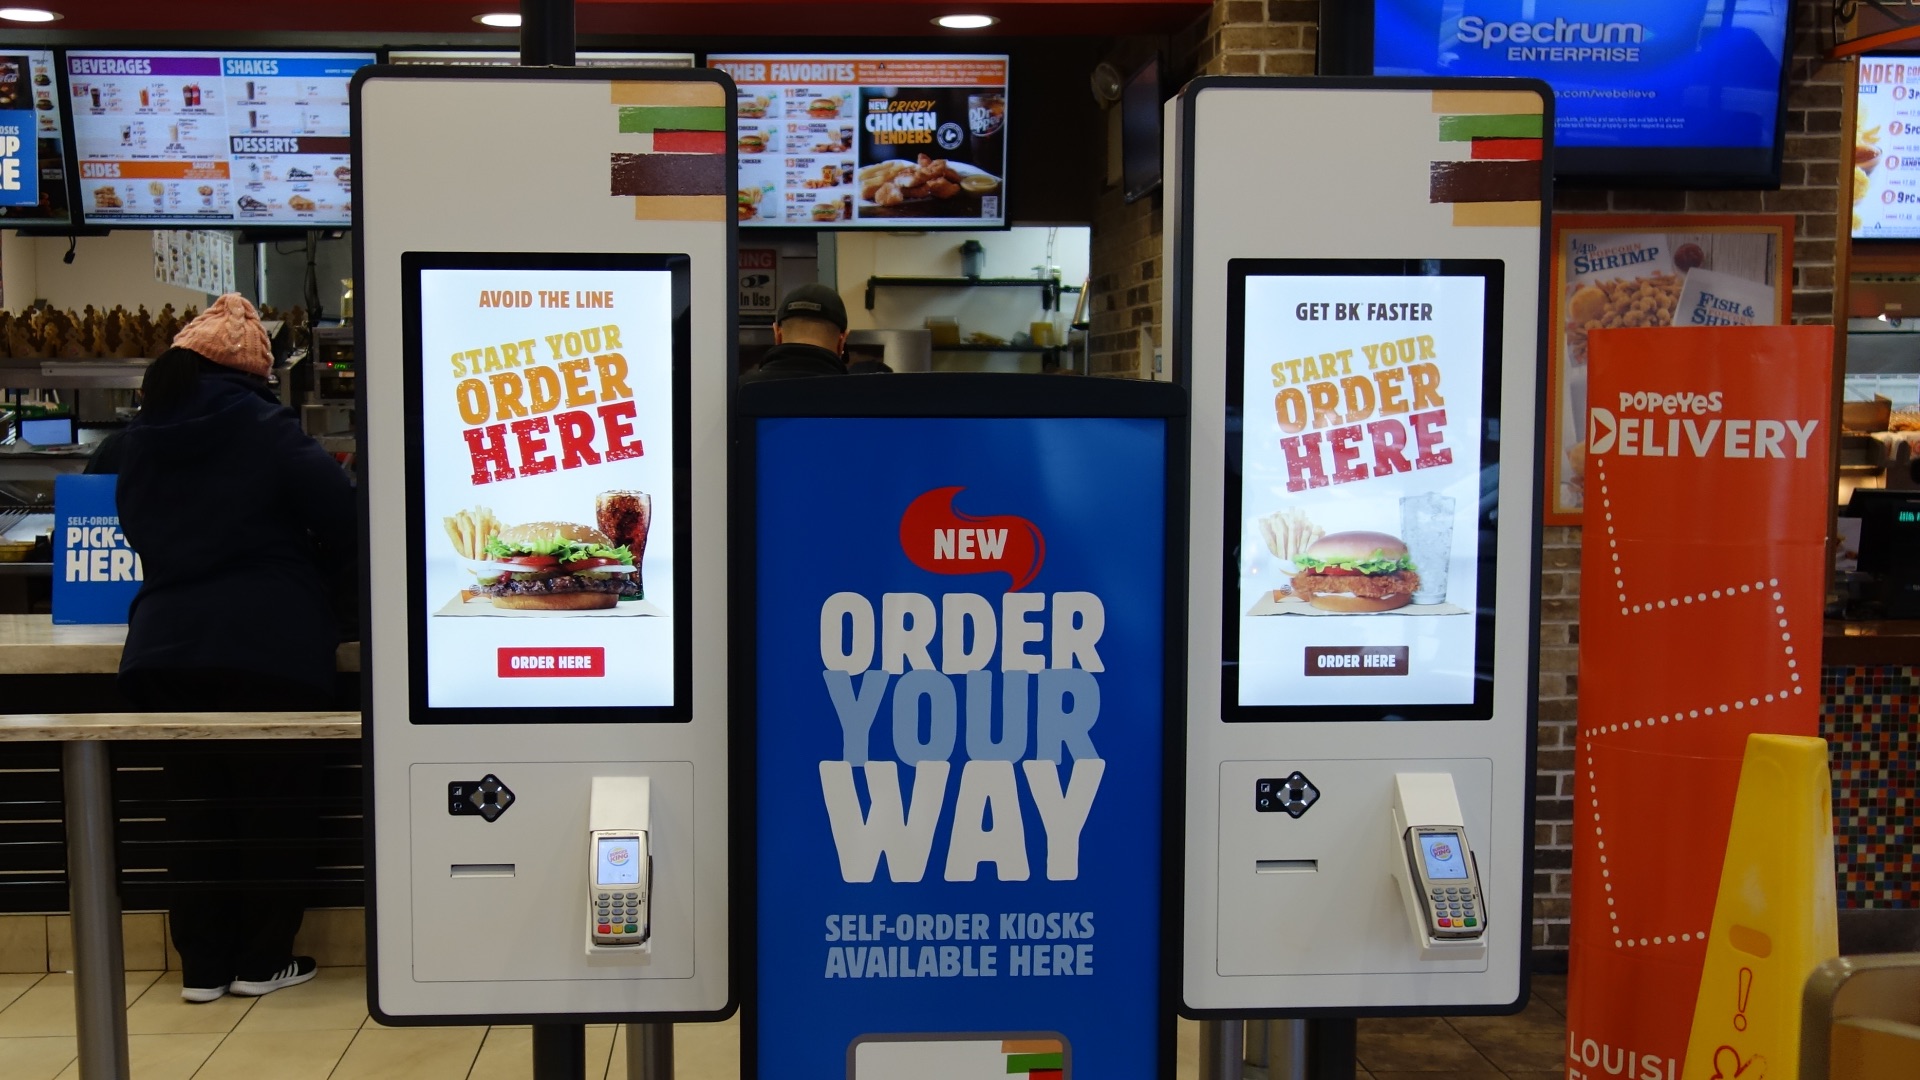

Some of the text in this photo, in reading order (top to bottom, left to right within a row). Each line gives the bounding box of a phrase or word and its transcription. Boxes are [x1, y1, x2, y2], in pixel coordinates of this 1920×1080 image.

[1457, 16, 1643, 49] Spectrum
[1508, 47, 1639, 62] ENTERPRISE
[72, 59, 151, 75] BEVERAGES
[227, 60, 278, 75] SHAKES
[770, 63, 856, 81] FAVORITES
[868, 100, 936, 112] NEW CRISPY
[865, 111, 937, 132] CHICKEN
[233, 138, 299, 153] DESSERTS
[873, 130, 932, 145] TENDERS
[83, 163, 121, 178] SIDES
[1574, 247, 1659, 275] SHRIMP
[479, 290, 614, 309] AVOID THE LINE
[740, 291, 770, 306] In Use
[1697, 291, 1755, 318] FISH &
[1296, 302, 1330, 321] GET
[1367, 302, 1433, 321] FASTER
[450, 324, 623, 378] START YOUR
[1270, 334, 1436, 388] START YOUR
[455, 352, 634, 426] ORDER
[1274, 362, 1445, 434] ORDER
[463, 400, 645, 486] HERE
[1590, 407, 1819, 459] DELIVERY
[1279, 408, 1453, 493] HERE
[67, 516, 120, 526] SELF-ORDER
[933, 528, 1009, 560] NEW
[820, 591, 1105, 676] ORDER
[511, 655, 592, 670] ORDER HERE
[1317, 654, 1396, 668] ORDER HERE
[822, 668, 1101, 767] YOUR
[818, 758, 1106, 883] WAY
[610, 852, 629, 862] KING
[825, 911, 1095, 942] SELF-ORDER KIOSKS
[824, 943, 1094, 979] AVAILABLE HERE
